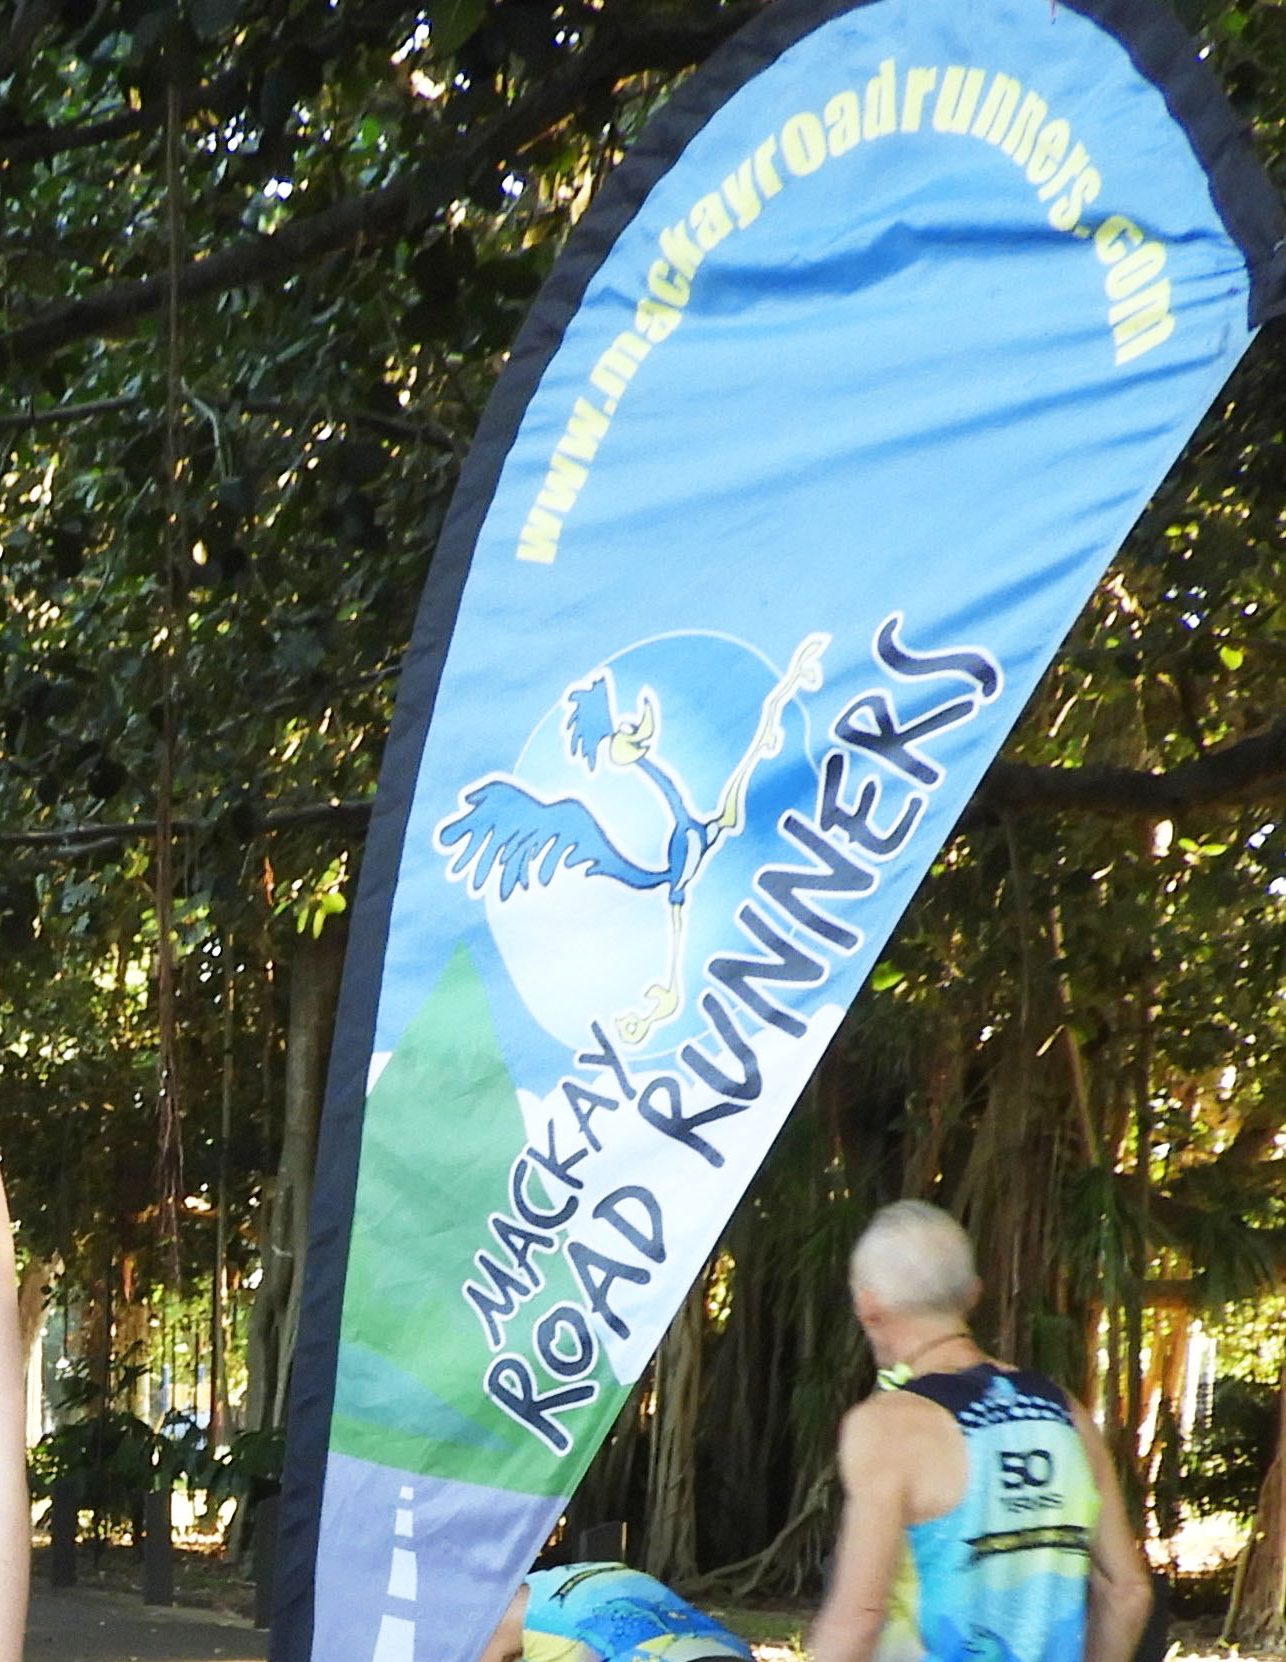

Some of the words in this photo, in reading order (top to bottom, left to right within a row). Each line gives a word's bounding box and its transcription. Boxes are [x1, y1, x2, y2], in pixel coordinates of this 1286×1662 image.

[516, 58, 1175, 564] www.mackayroadrunners.com
[463, 1020, 637, 1346] MACKAY
[489, 1184, 667, 1448] ROAD
[637, 618, 999, 1168] RUNNERS
[1000, 1449, 1052, 1489] 50
